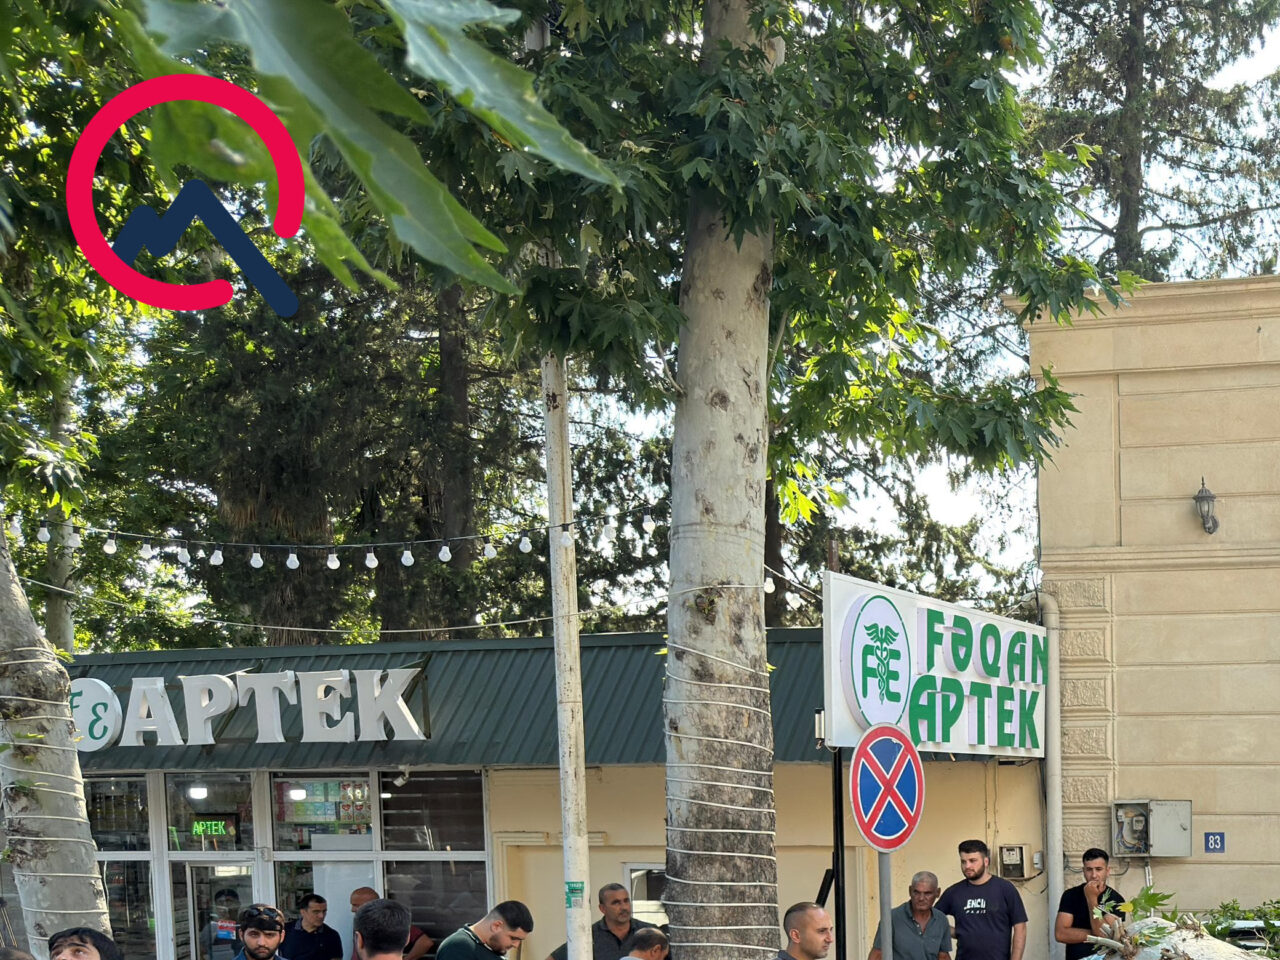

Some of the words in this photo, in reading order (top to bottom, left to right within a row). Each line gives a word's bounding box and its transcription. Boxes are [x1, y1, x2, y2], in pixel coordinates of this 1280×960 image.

[920, 608, 1048, 686] FƏQAN
[118, 668, 431, 747] APTEK
[908, 674, 1040, 749] APTEK
[192, 821, 226, 835] APTEK
[1208, 835, 1221, 849] 83
